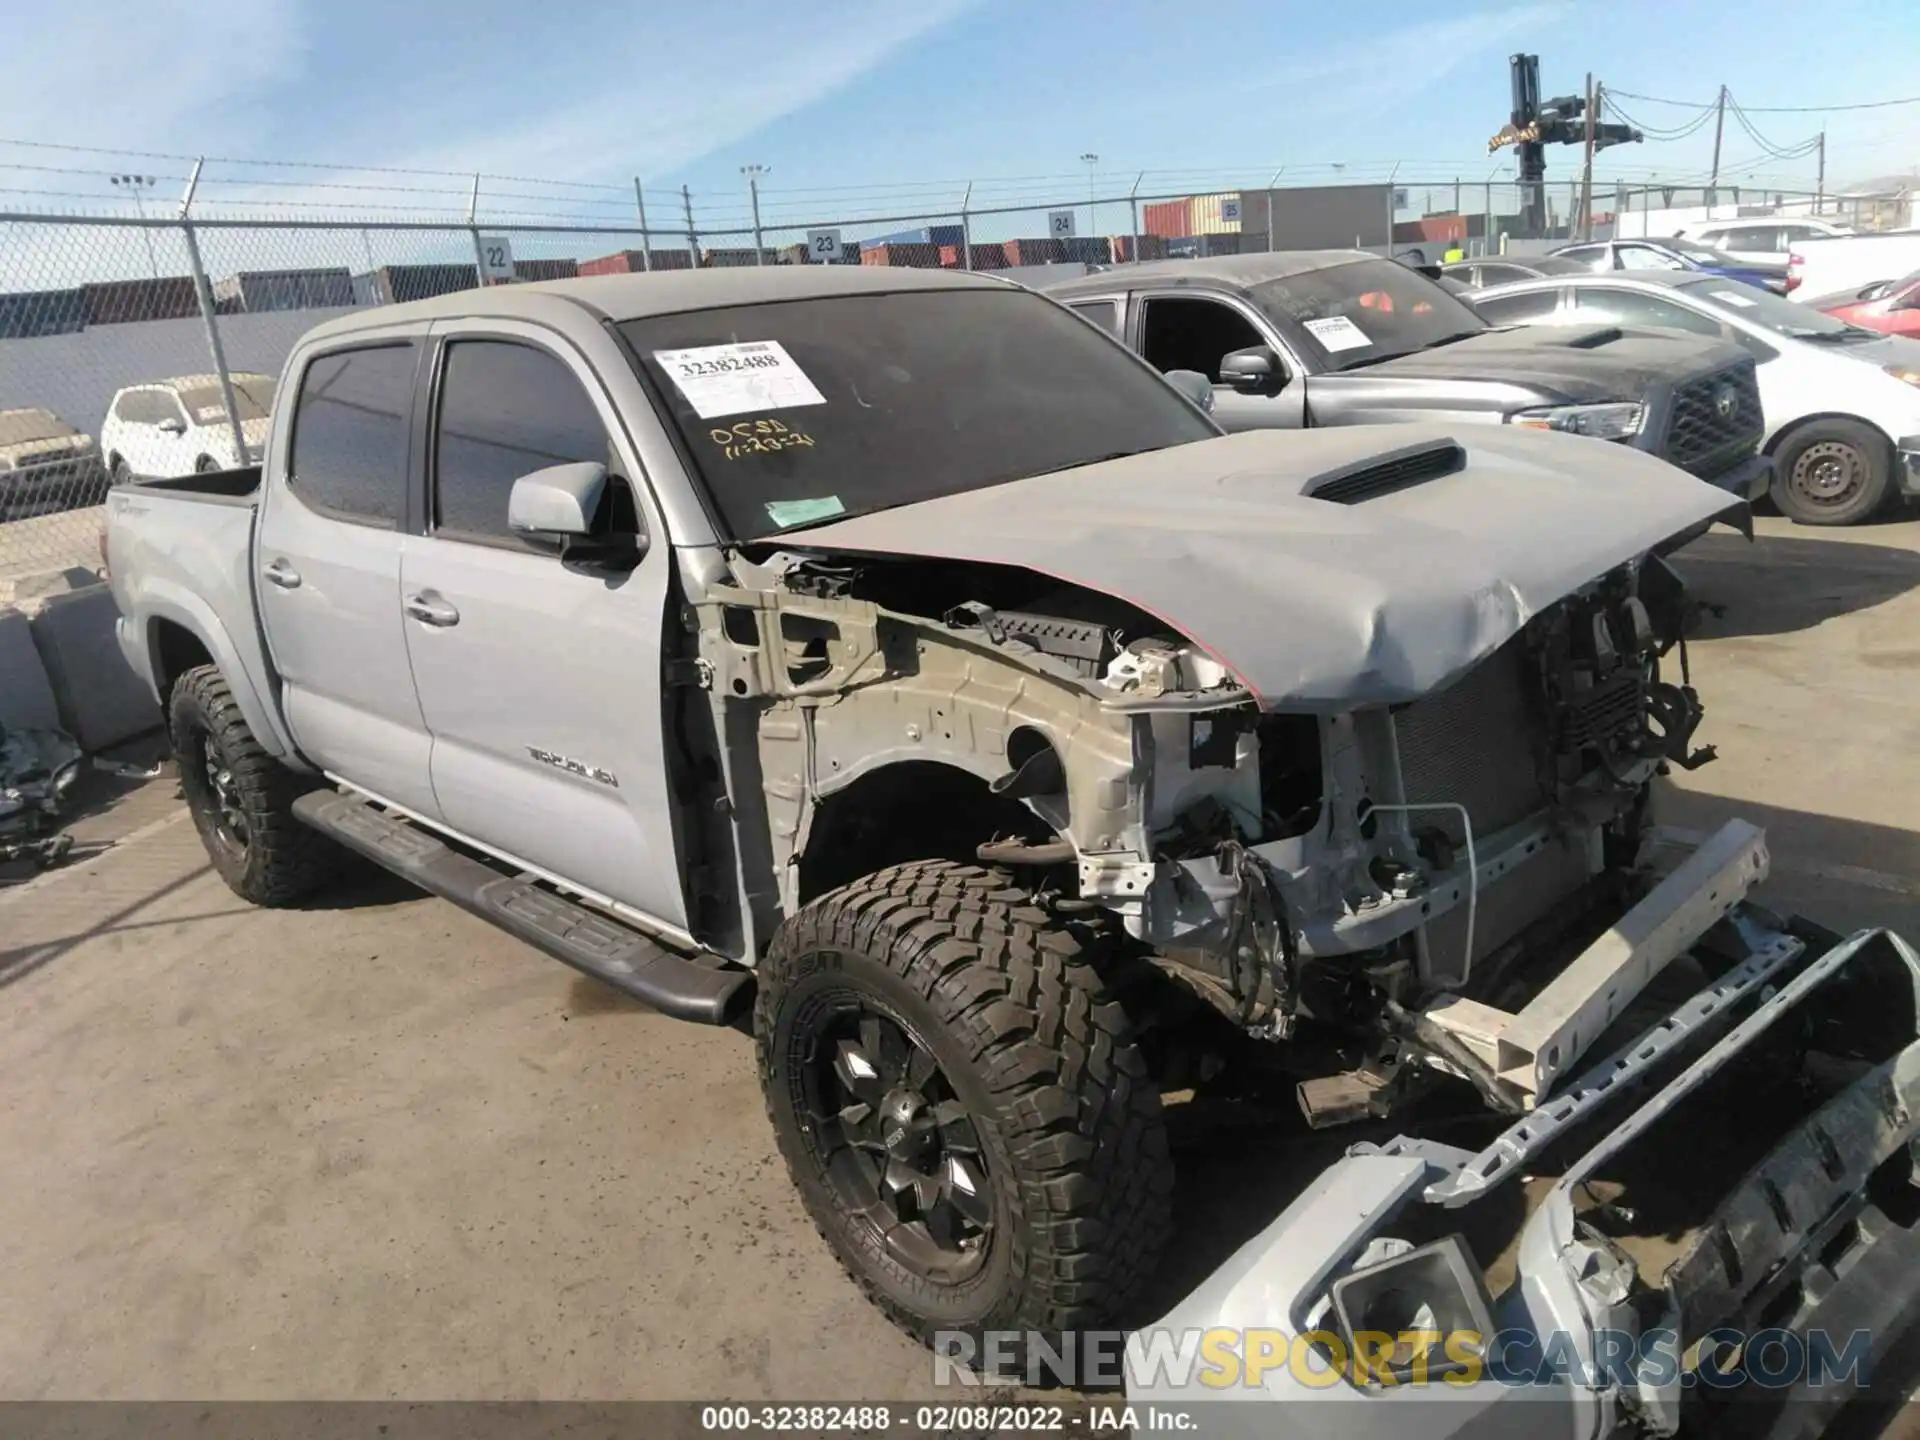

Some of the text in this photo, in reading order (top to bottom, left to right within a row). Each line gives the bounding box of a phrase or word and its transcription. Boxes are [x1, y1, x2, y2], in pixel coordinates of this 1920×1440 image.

[1054, 217, 1070, 232] 24
[816, 236, 834, 252] 23
[487, 246, 506, 268] 22
[678, 353, 780, 377] 32382488
